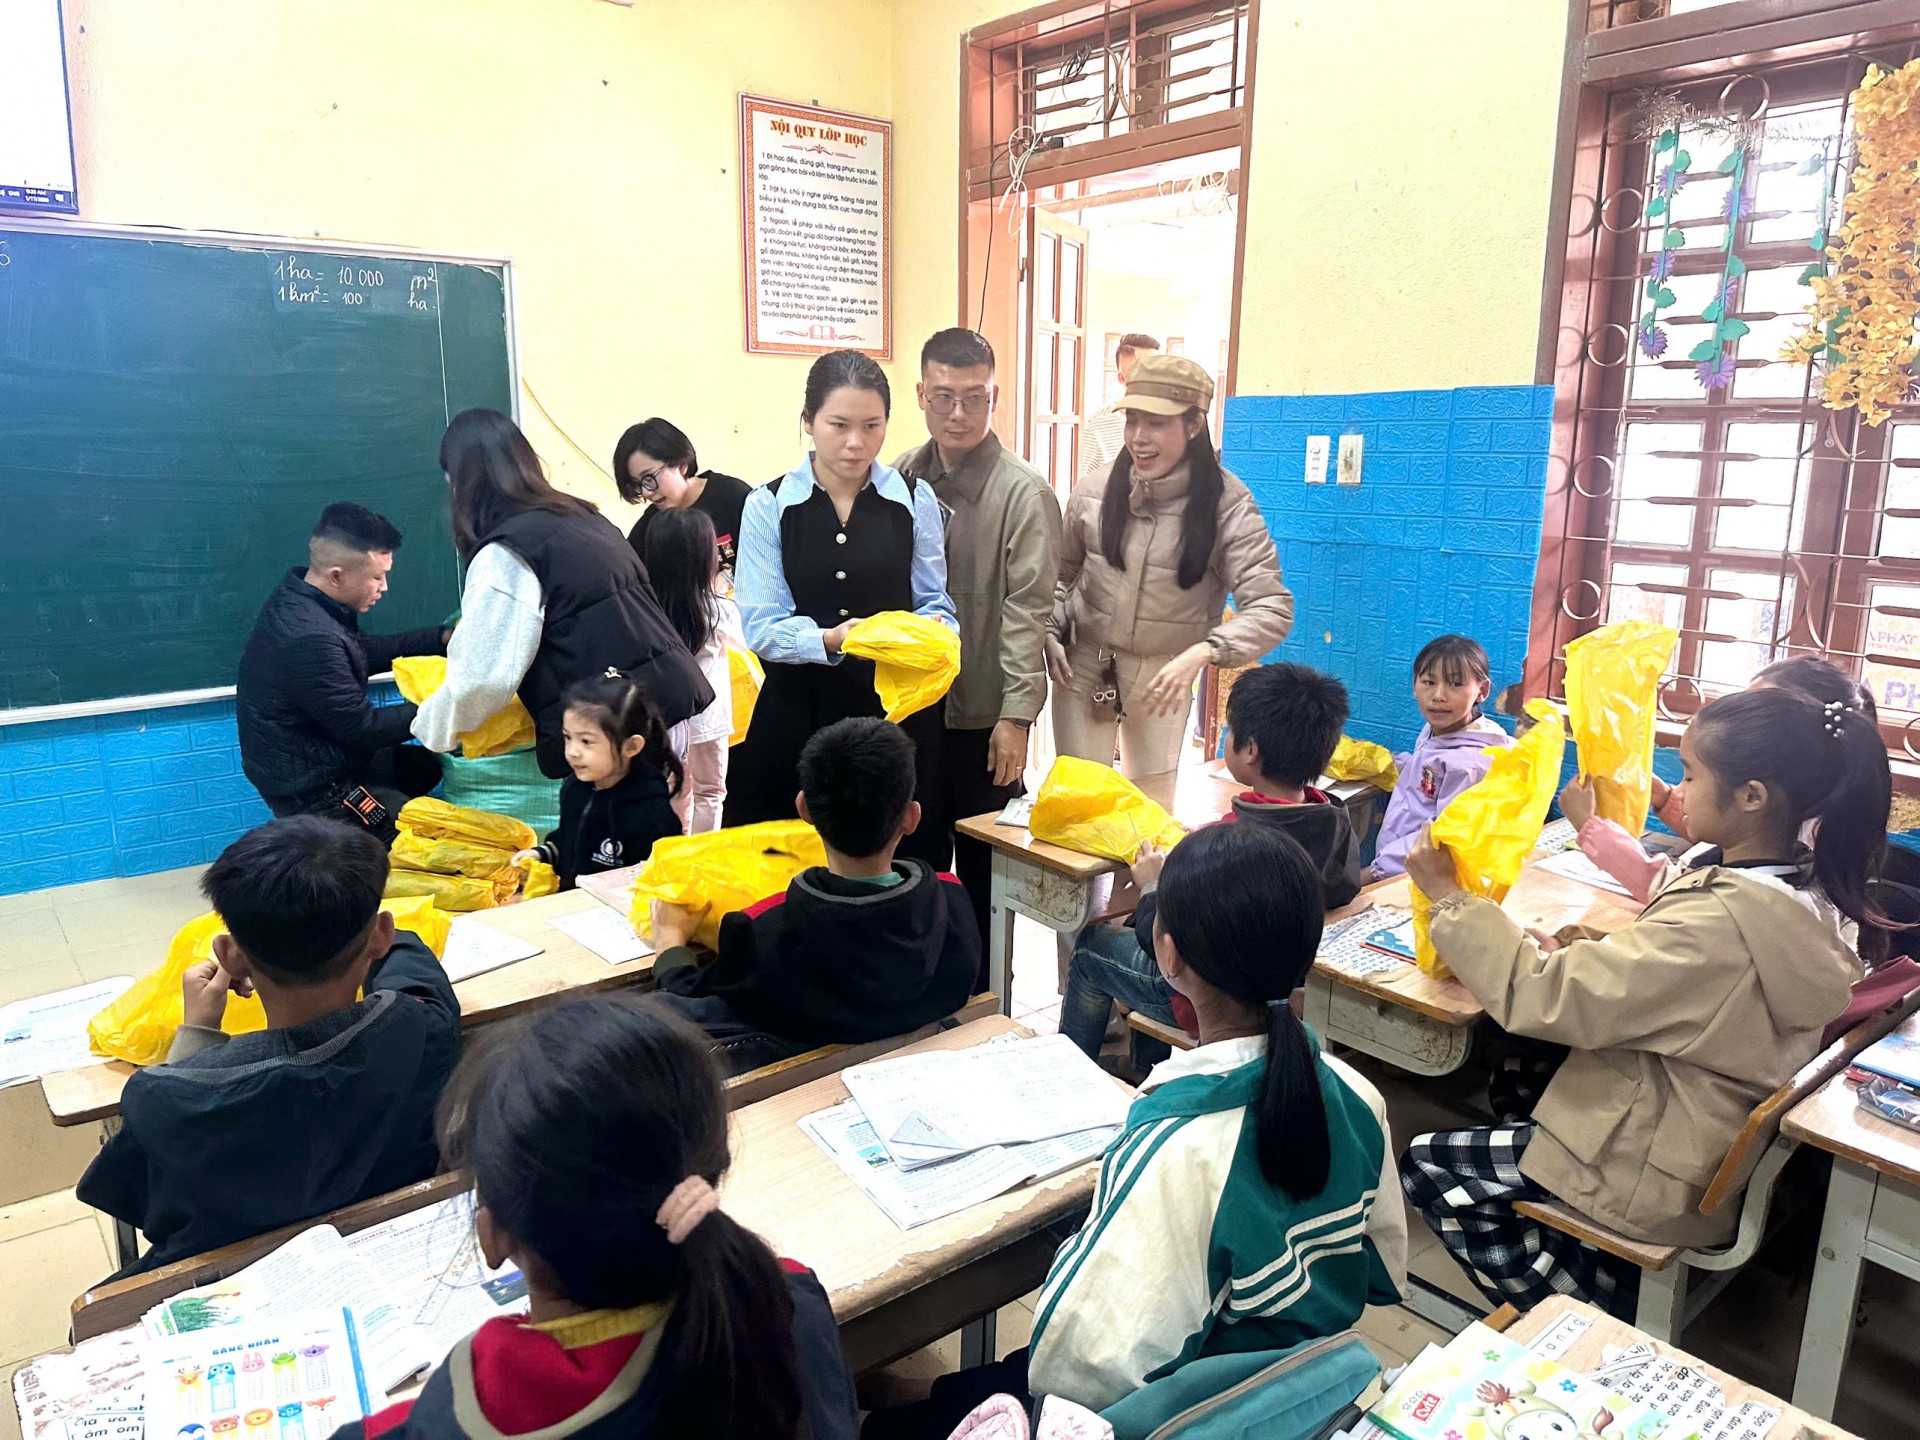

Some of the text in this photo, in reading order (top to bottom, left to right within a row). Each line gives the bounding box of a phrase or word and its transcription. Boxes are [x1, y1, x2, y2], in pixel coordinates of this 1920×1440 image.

[770, 118, 867, 148] NỘI QUY LỚP HỌC
[773, 154, 785, 162] học
[799, 158, 814, 167] đúng
[826, 162, 841, 171] trang
[841, 165, 855, 173] phục
[786, 166, 798, 174] học
[864, 208, 878, 217] động
[850, 247, 866, 256] không
[342, 291, 363, 305] 100
